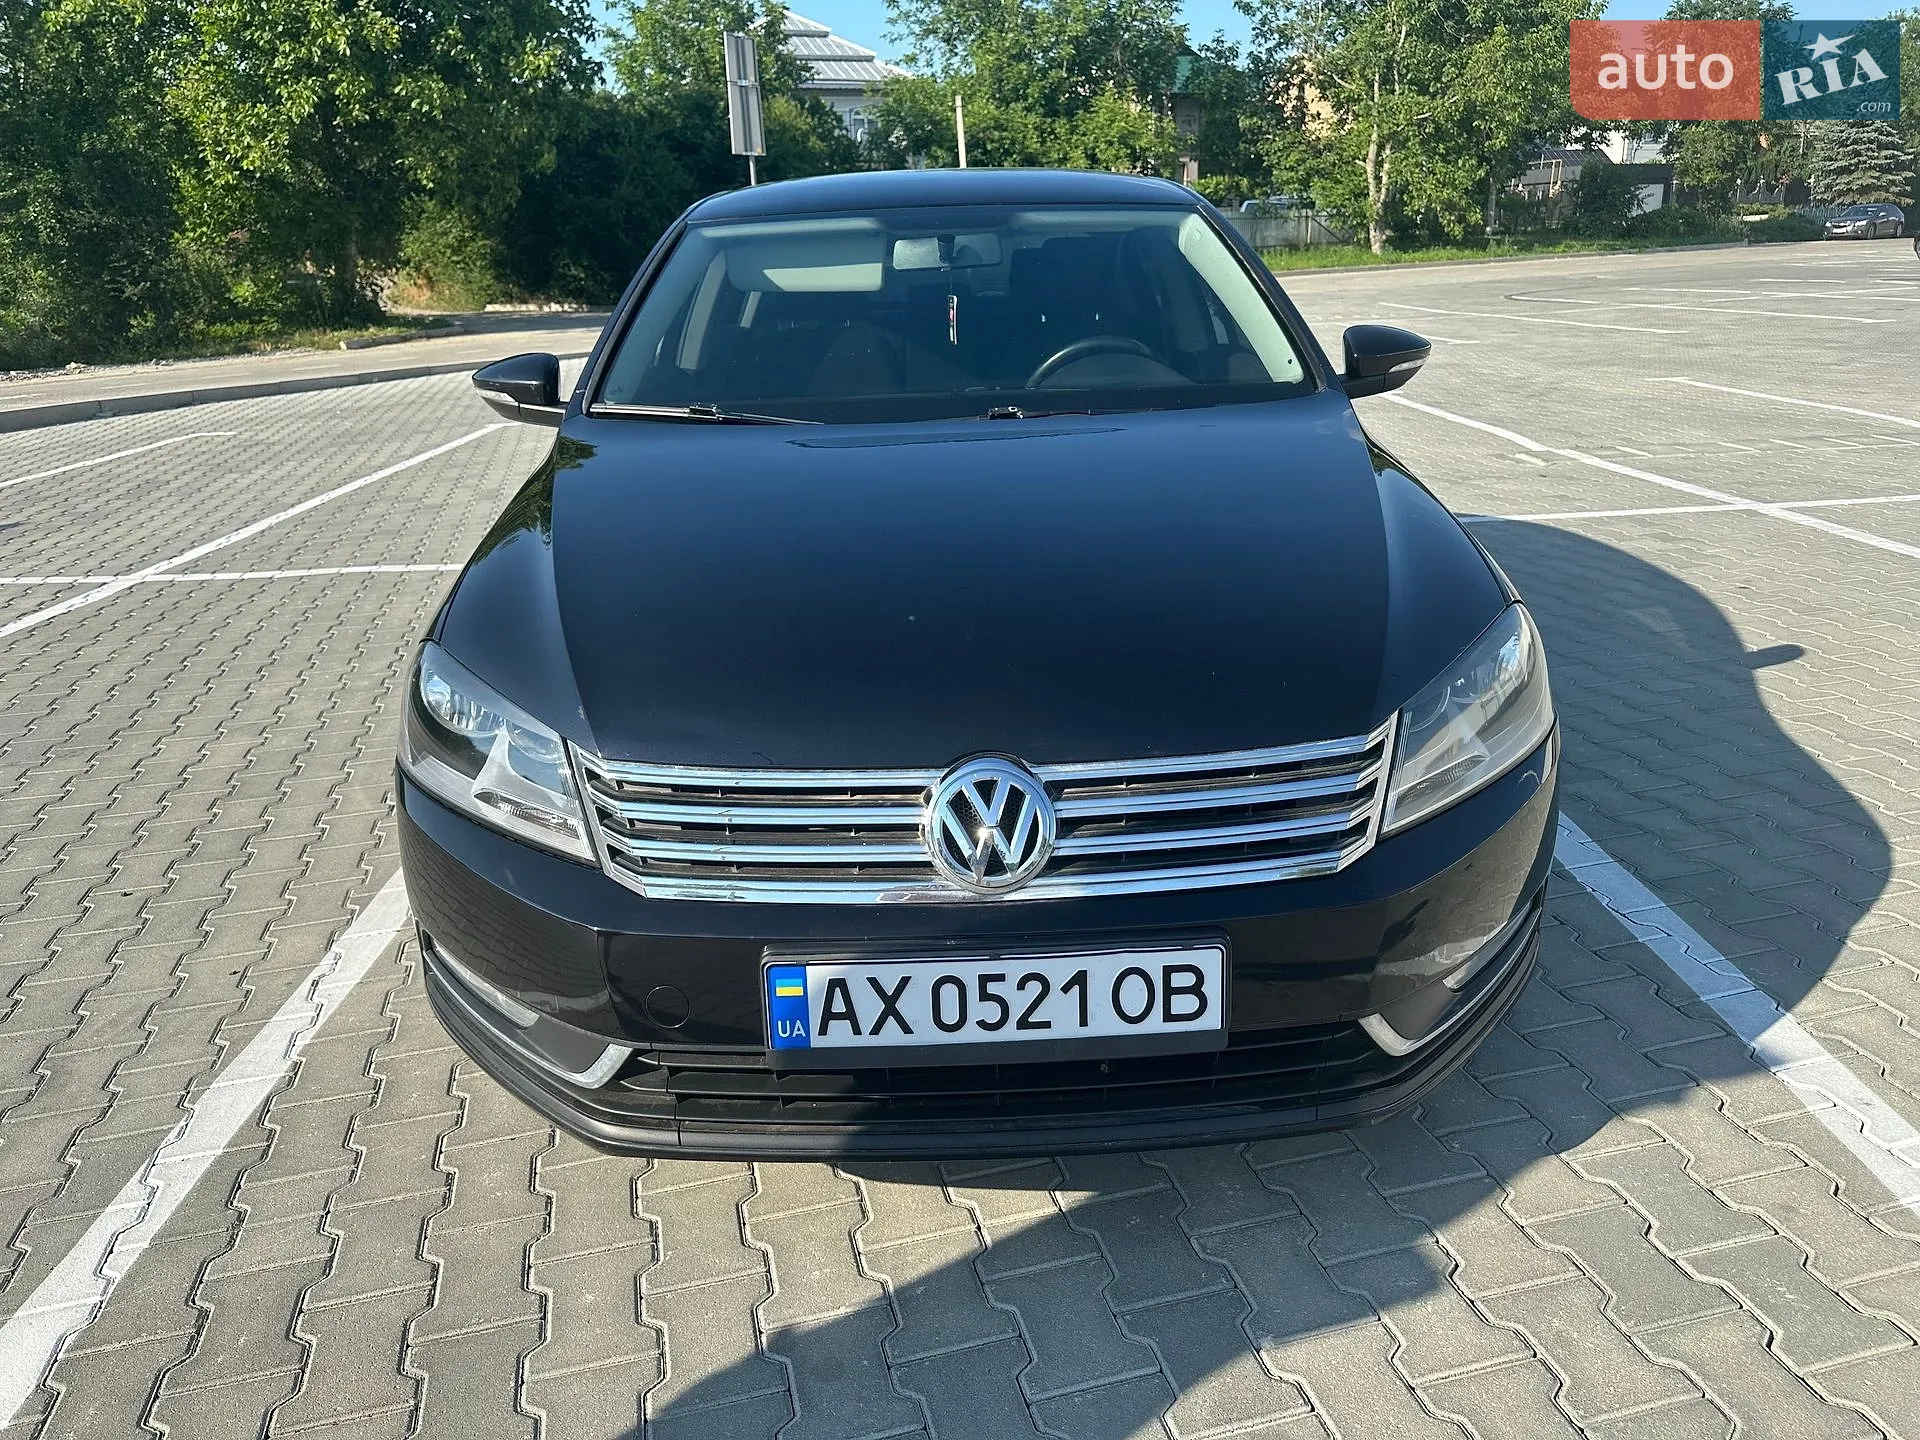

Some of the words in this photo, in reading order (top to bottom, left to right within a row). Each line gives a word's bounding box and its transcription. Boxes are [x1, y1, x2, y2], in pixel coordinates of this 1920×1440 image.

[817, 975, 915, 1037] AX
[931, 969, 1090, 1033] 0521
[1112, 963, 1208, 1025] OB
[776, 1020, 807, 1038] UA
